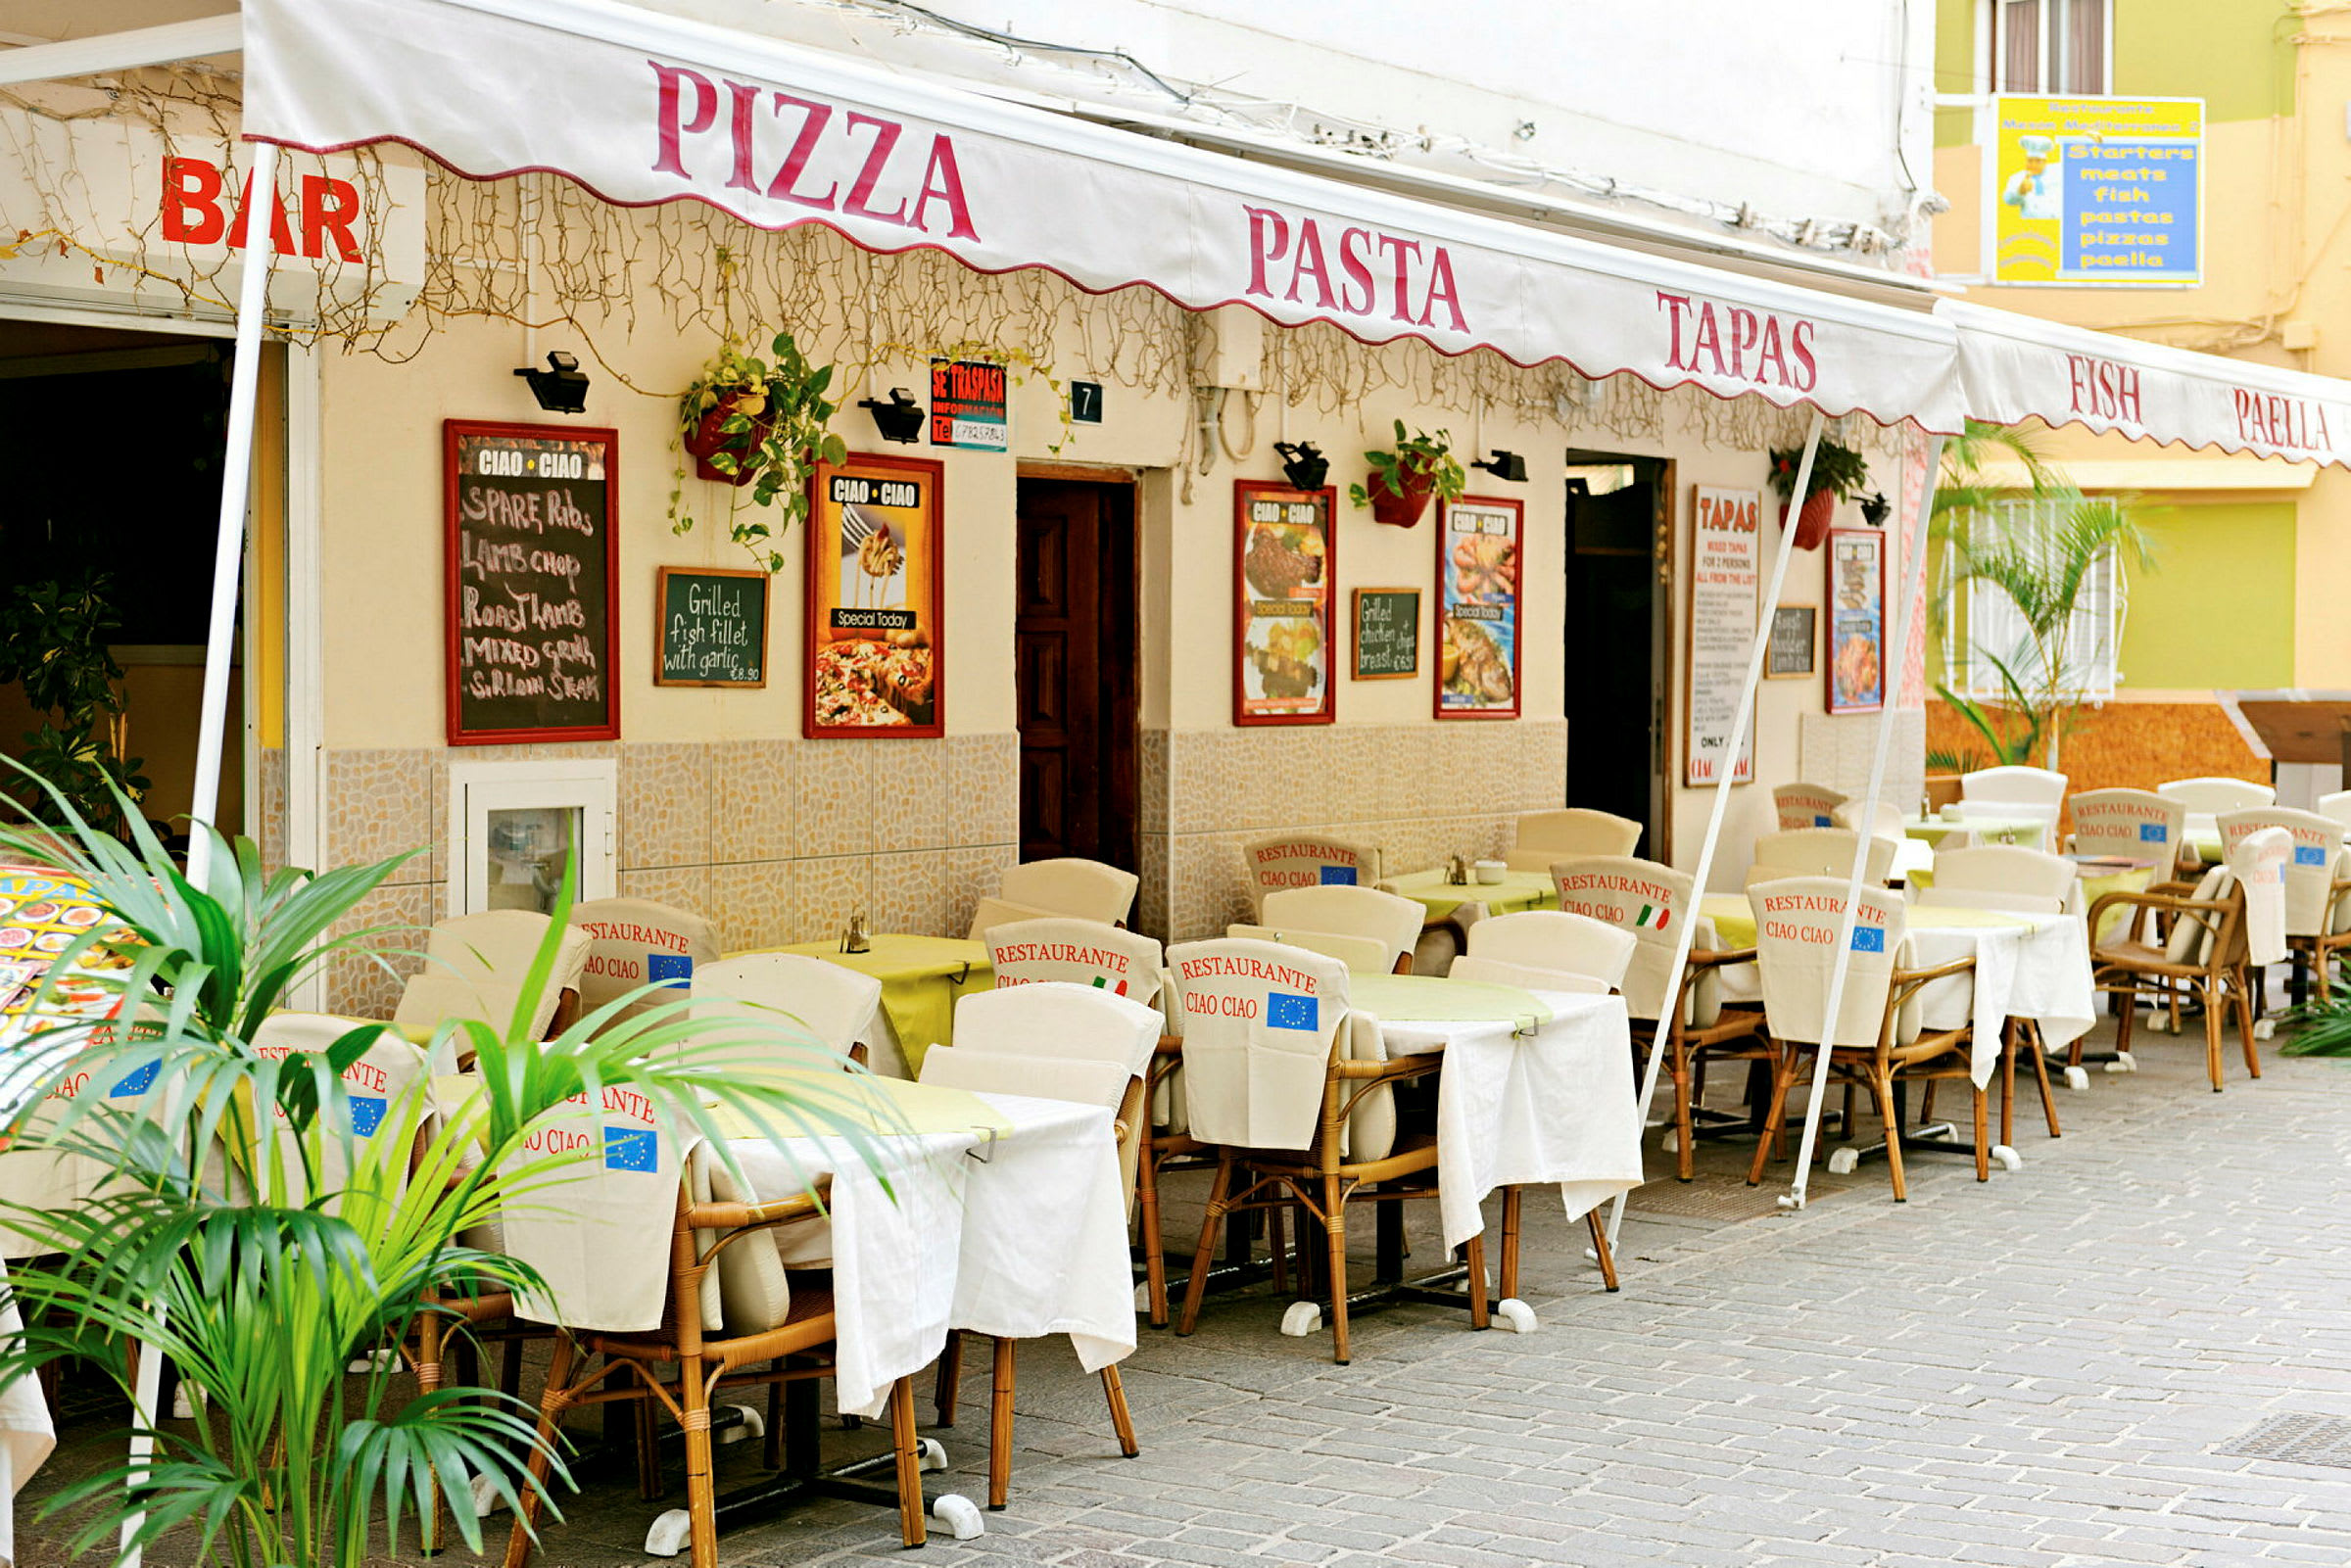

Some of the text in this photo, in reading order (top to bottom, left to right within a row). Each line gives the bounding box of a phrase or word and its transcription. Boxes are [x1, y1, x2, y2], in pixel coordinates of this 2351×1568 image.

[648, 59, 982, 244] PIZZA
[2068, 144, 2195, 160] Starters
[2081, 167, 2167, 181] meats
[163, 155, 364, 264] BAR
[2094, 187, 2149, 203] fish
[2081, 211, 2174, 227] pastas
[2081, 230, 2169, 248] pizzas
[1241, 204, 1471, 334] PASTA
[2081, 252, 2163, 269] paella
[1656, 290, 1816, 393] TAPAS
[933, 364, 1003, 404] SE TRASPASA
[2066, 353, 2143, 425] FISH
[1082, 388, 1092, 415] 7
[2233, 386, 2332, 451] PAELLA
[479, 450, 582, 479] CIAO CIAO
[834, 478, 916, 508] CIAO CIAO
[462, 486, 544, 535] SPARE
[1254, 502, 1316, 525] CIAO CIAO
[1701, 496, 1756, 534] TAPAS
[690, 583, 741, 618] Grilled
[670, 613, 748, 646] fish fillet
[838, 610, 909, 630] Special Today
[663, 643, 740, 678] with garlic
[1702, 736, 1724, 748] ONLY
[1257, 843, 1358, 866] RESTAURANTE
[1260, 871, 1318, 887] CIAO CIAO
[1561, 874, 1672, 904] RESTAURANTE
[1564, 899, 1624, 924] CIAO CIAO
[582, 923, 690, 954] STAURANTE
[1766, 921, 1834, 945] CIAO CIAO
[608, 958, 640, 979] CIAO
[995, 943, 1129, 974] RESTAURANTE
[1181, 957, 1317, 994] RESTAURANTE
[1186, 991, 1258, 1020] CIAO CIAO
